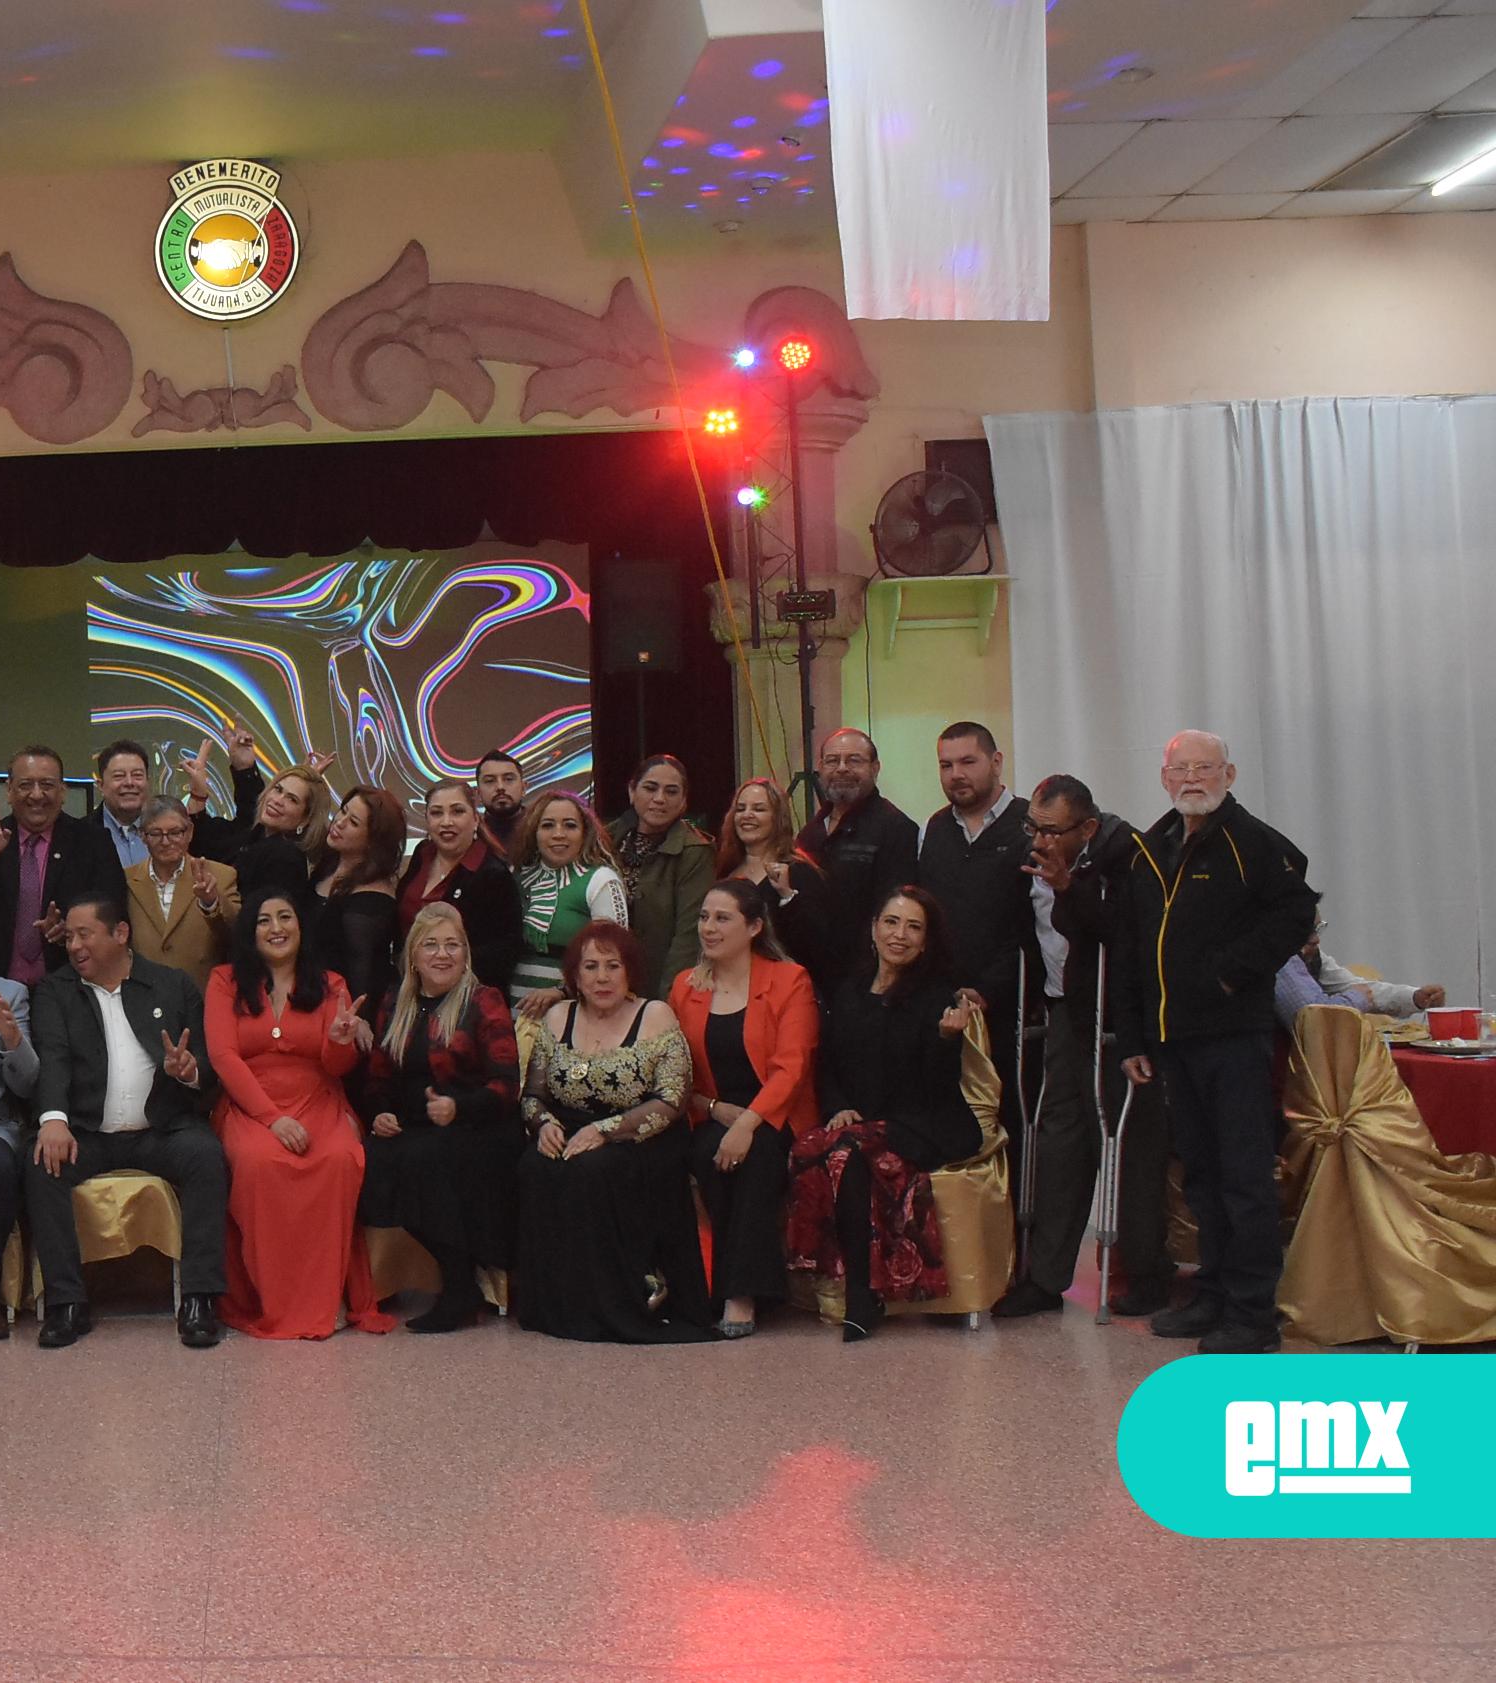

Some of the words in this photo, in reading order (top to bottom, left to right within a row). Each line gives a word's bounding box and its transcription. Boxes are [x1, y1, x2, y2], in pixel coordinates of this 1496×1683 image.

[173, 161, 278, 191] BENEMERITO
[193, 192, 261, 214] MUTUALISTA
[168, 219, 188, 282] CENTRO
[267, 216, 287, 283] ZARAGOZA
